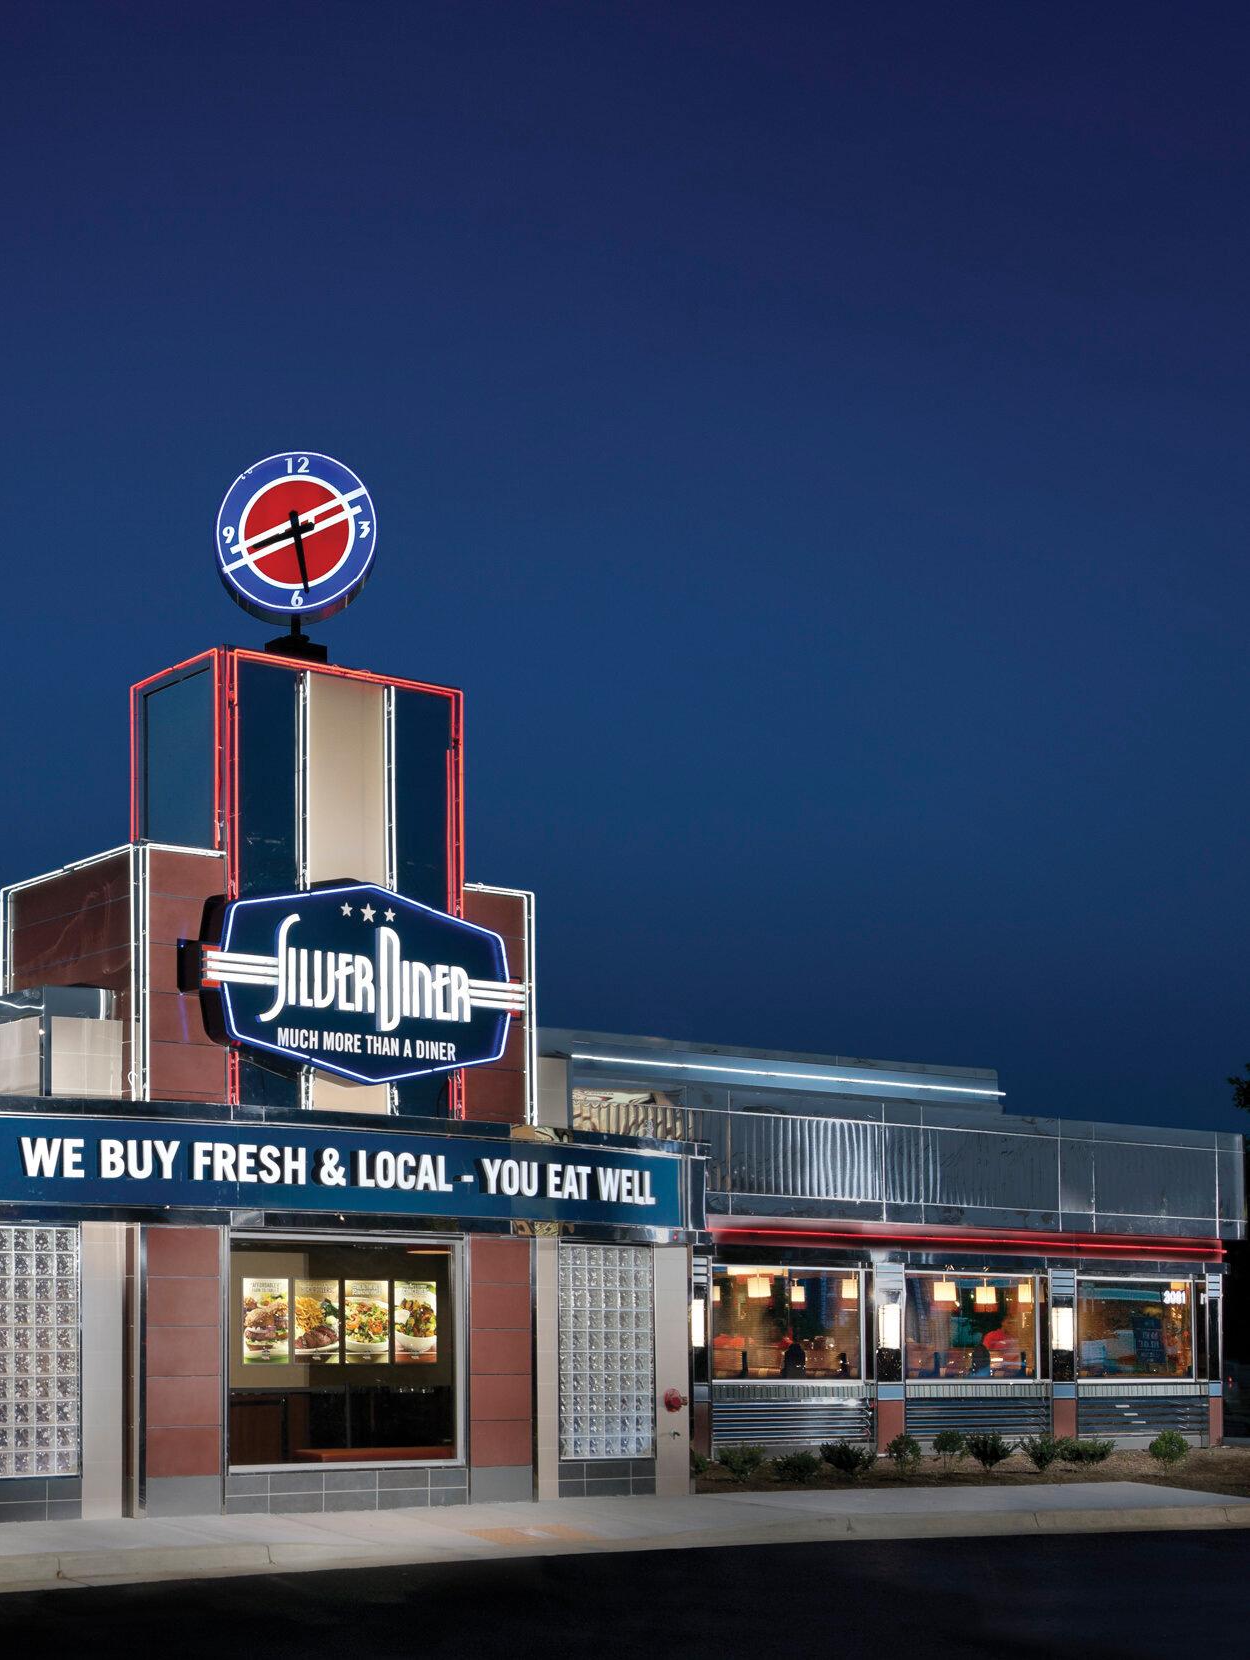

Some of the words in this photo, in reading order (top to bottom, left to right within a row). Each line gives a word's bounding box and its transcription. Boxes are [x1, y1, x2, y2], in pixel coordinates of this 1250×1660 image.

[285, 457, 309, 474] 12
[222, 526, 235, 544] 9
[358, 521, 371, 538] 3
[290, 590, 304, 607] 6
[255, 914, 375, 1023] SILVER
[277, 1027, 318, 1050] MUCH
[323, 1032, 362, 1053] MORE
[365, 1035, 399, 1056] THAN
[403, 1039, 412, 1058] A
[416, 1040, 456, 1061] DINER
[20, 1137, 85, 1178] WE
[100, 1139, 180, 1179] BUY
[193, 1142, 306, 1185] FRESH
[320, 1147, 347, 1187] &
[357, 1150, 453, 1192] LOCAL
[481, 1158, 539, 1197] YOU
[547, 1163, 592, 1200] EAT
[596, 1167, 656, 1205] WELL
